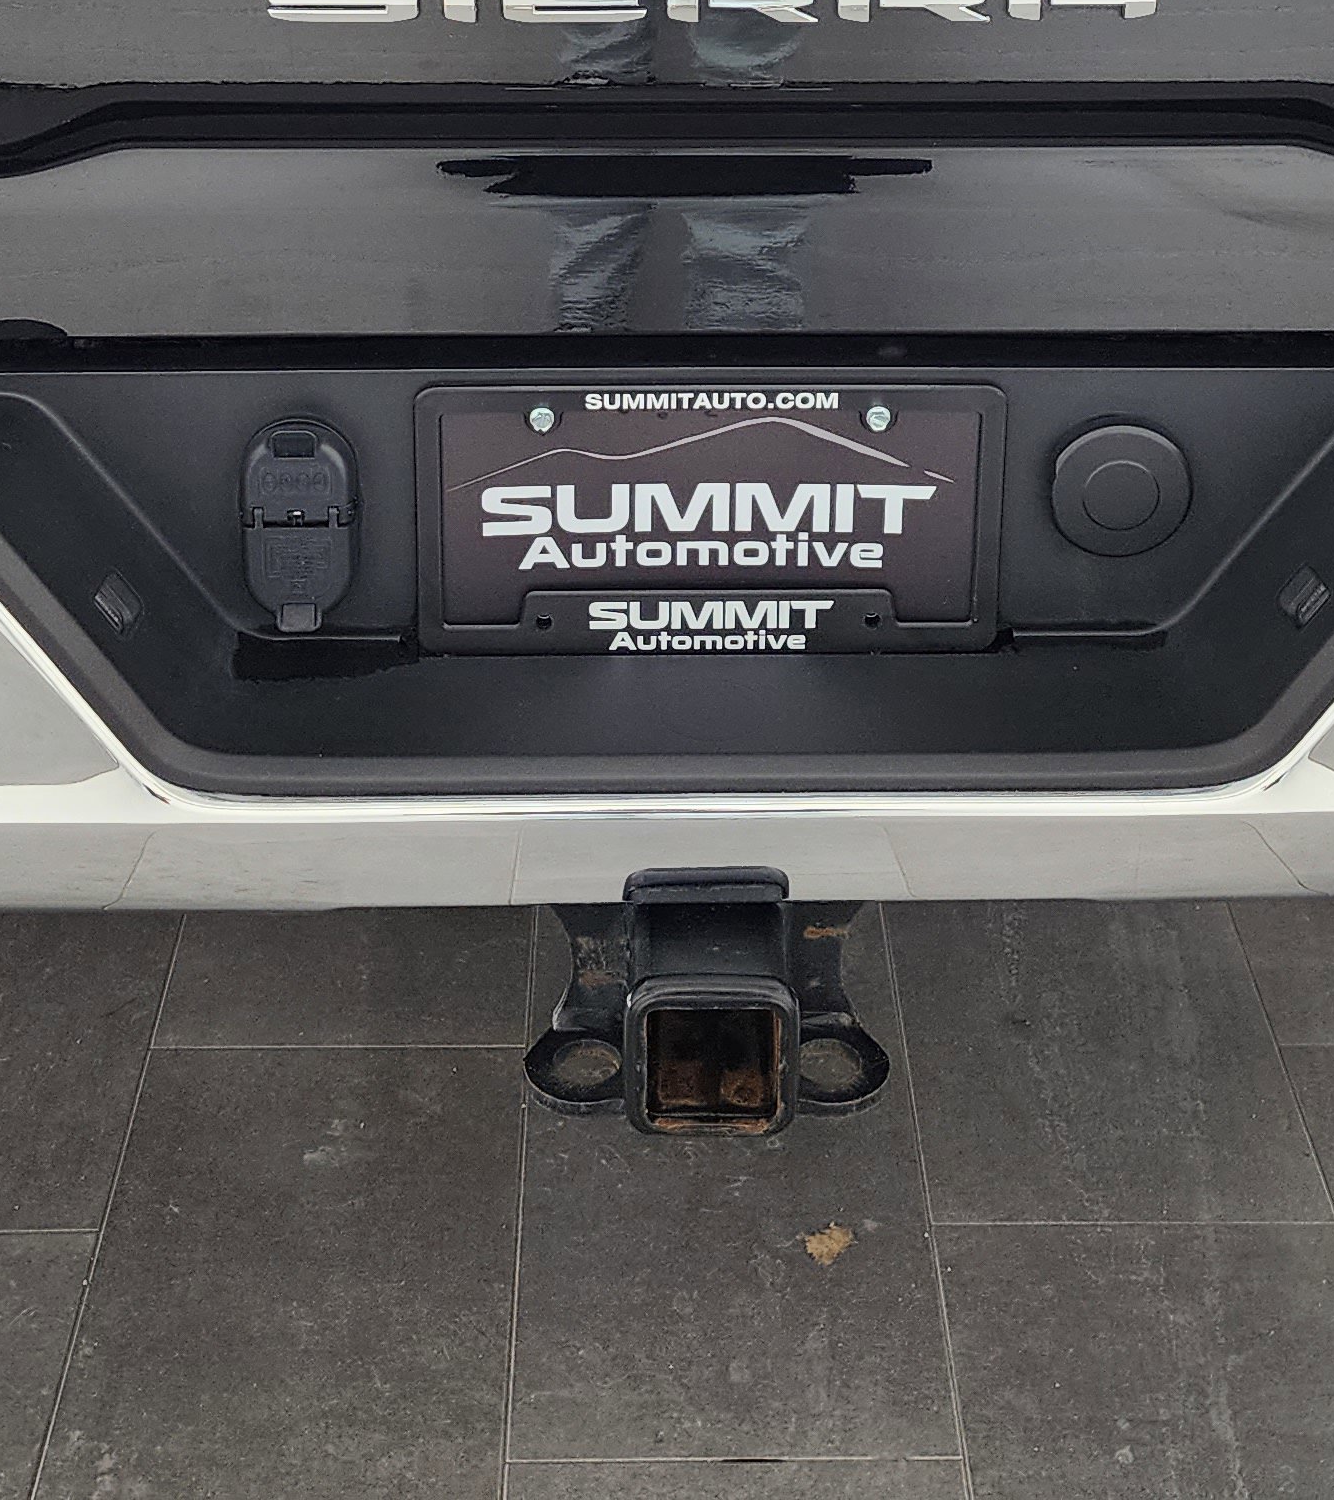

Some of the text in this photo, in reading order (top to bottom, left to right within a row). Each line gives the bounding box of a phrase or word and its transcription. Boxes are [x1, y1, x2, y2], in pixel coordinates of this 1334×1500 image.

[585, 392, 838, 410] SUMMITAUTO.COM
[481, 482, 937, 536] SUMMIT
[518, 532, 884, 570] Automotive
[589, 600, 834, 630] SUMMIT
[608, 629, 807, 651] Automotive
